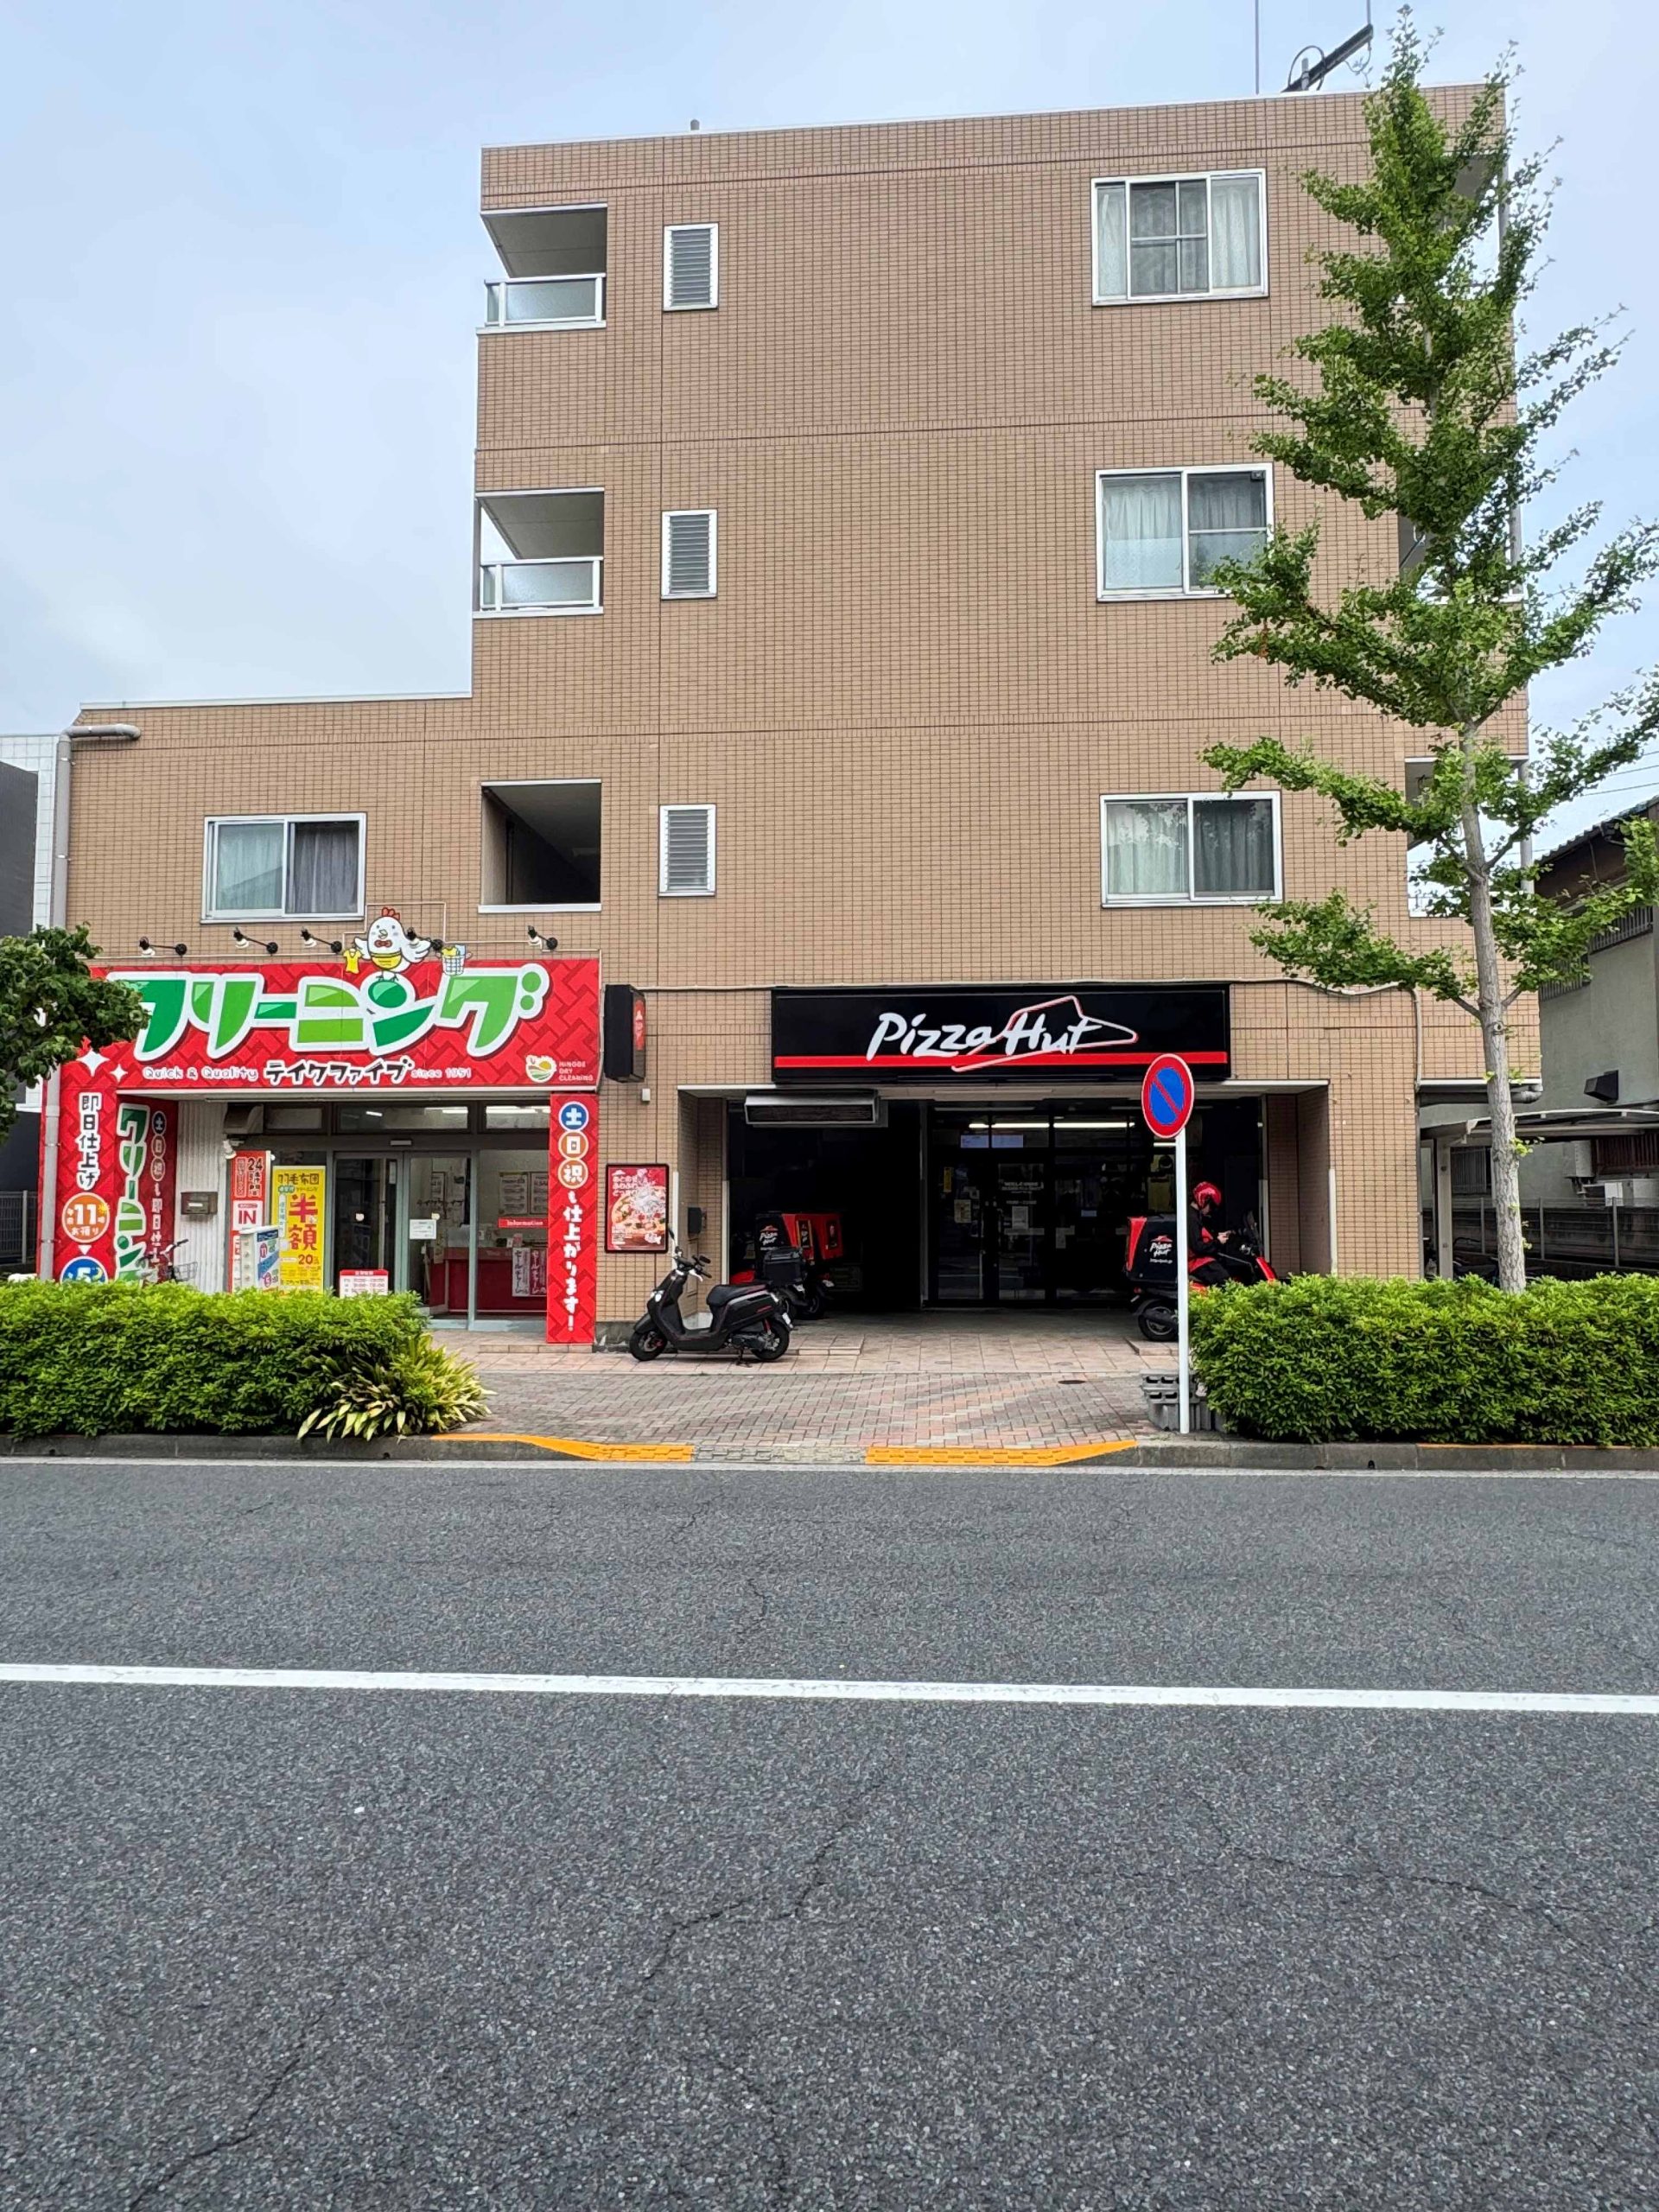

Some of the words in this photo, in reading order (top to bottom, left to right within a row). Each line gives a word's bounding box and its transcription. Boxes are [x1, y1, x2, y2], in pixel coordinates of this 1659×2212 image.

[866, 1012, 995, 1061] Pizza
[1001, 1011, 1103, 1057] Hut
[143, 1066, 182, 1079] Quick
[188, 1067, 198, 1080] &
[202, 1066, 258, 1082] Quality
[266, 1059, 412, 1084] テイクファイブ
[412, 1071, 442, 1079] since
[79, 1095, 99, 1189] 即日仕上げ
[117, 1107, 148, 1282] クリーニン
[238, 1211, 257, 1224] IN
[289, 1193, 318, 1251] 半額
[298, 1255, 313, 1265] 20
[1149, 1242, 1173, 1252] Pizza
